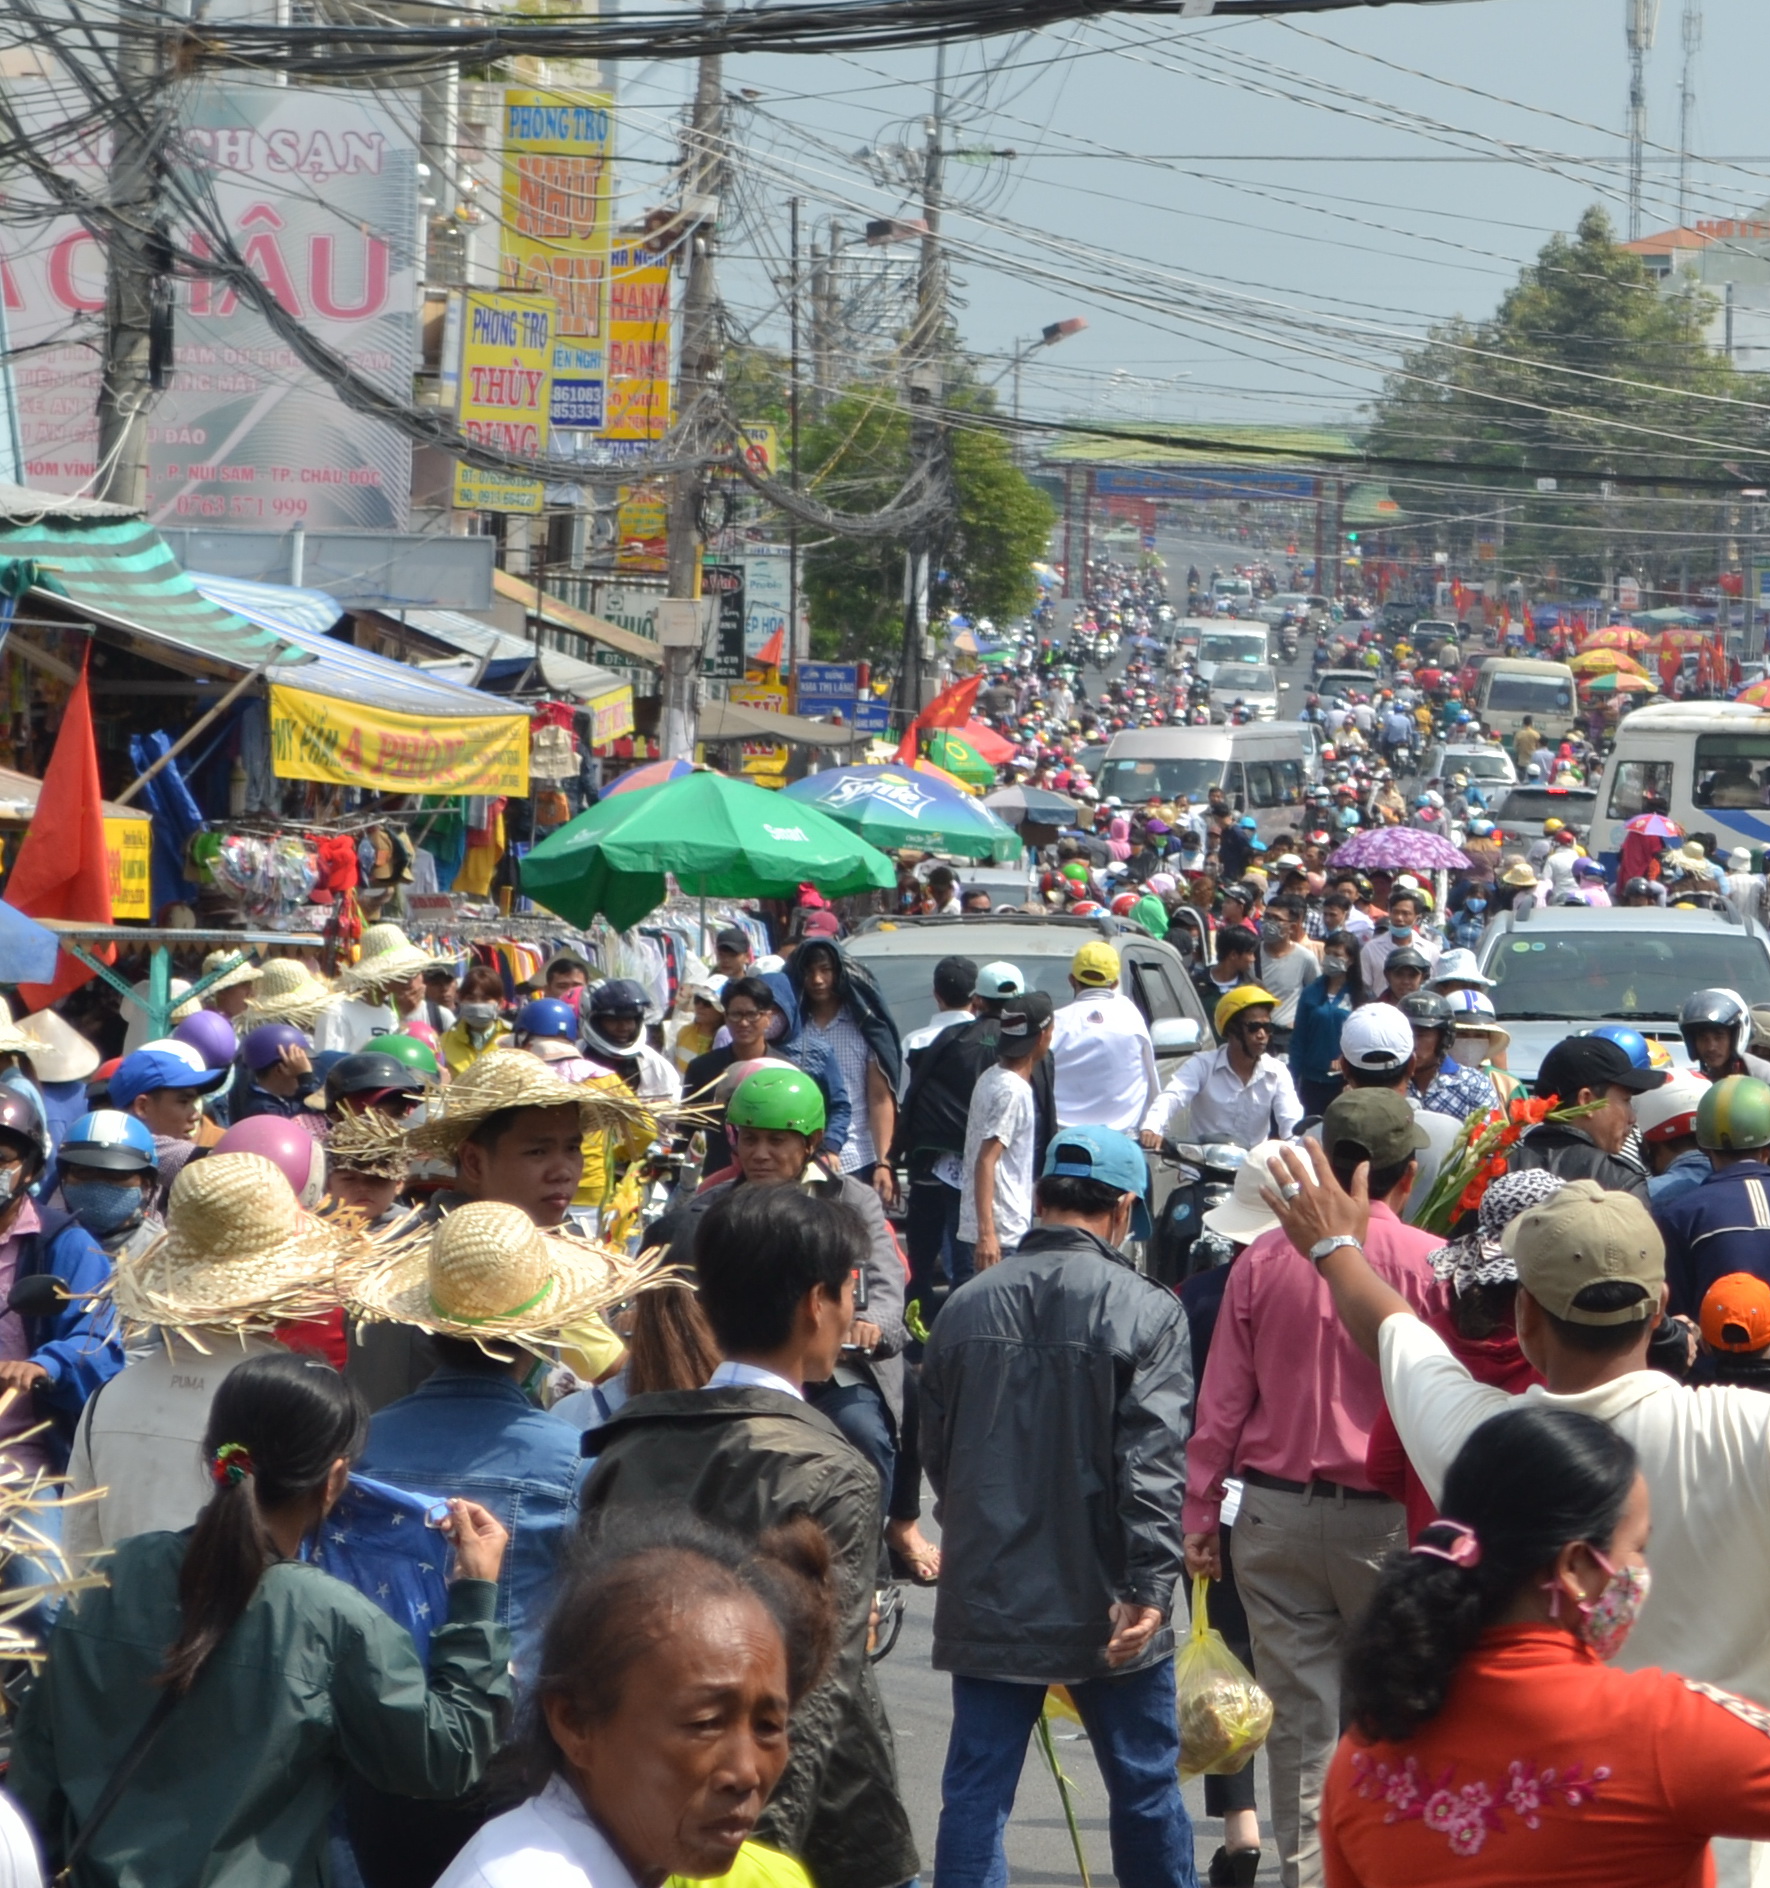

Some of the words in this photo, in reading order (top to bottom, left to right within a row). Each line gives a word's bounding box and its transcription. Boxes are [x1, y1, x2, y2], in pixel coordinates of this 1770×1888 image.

[508, 97, 570, 141] PHÒNG
[266, 130, 384, 182] SẠN
[472, 298, 518, 347] PHÒNG
[470, 356, 546, 410] THÙY
[831, 779, 922, 807] Sprite
[169, 1374, 206, 1391] PUMA
